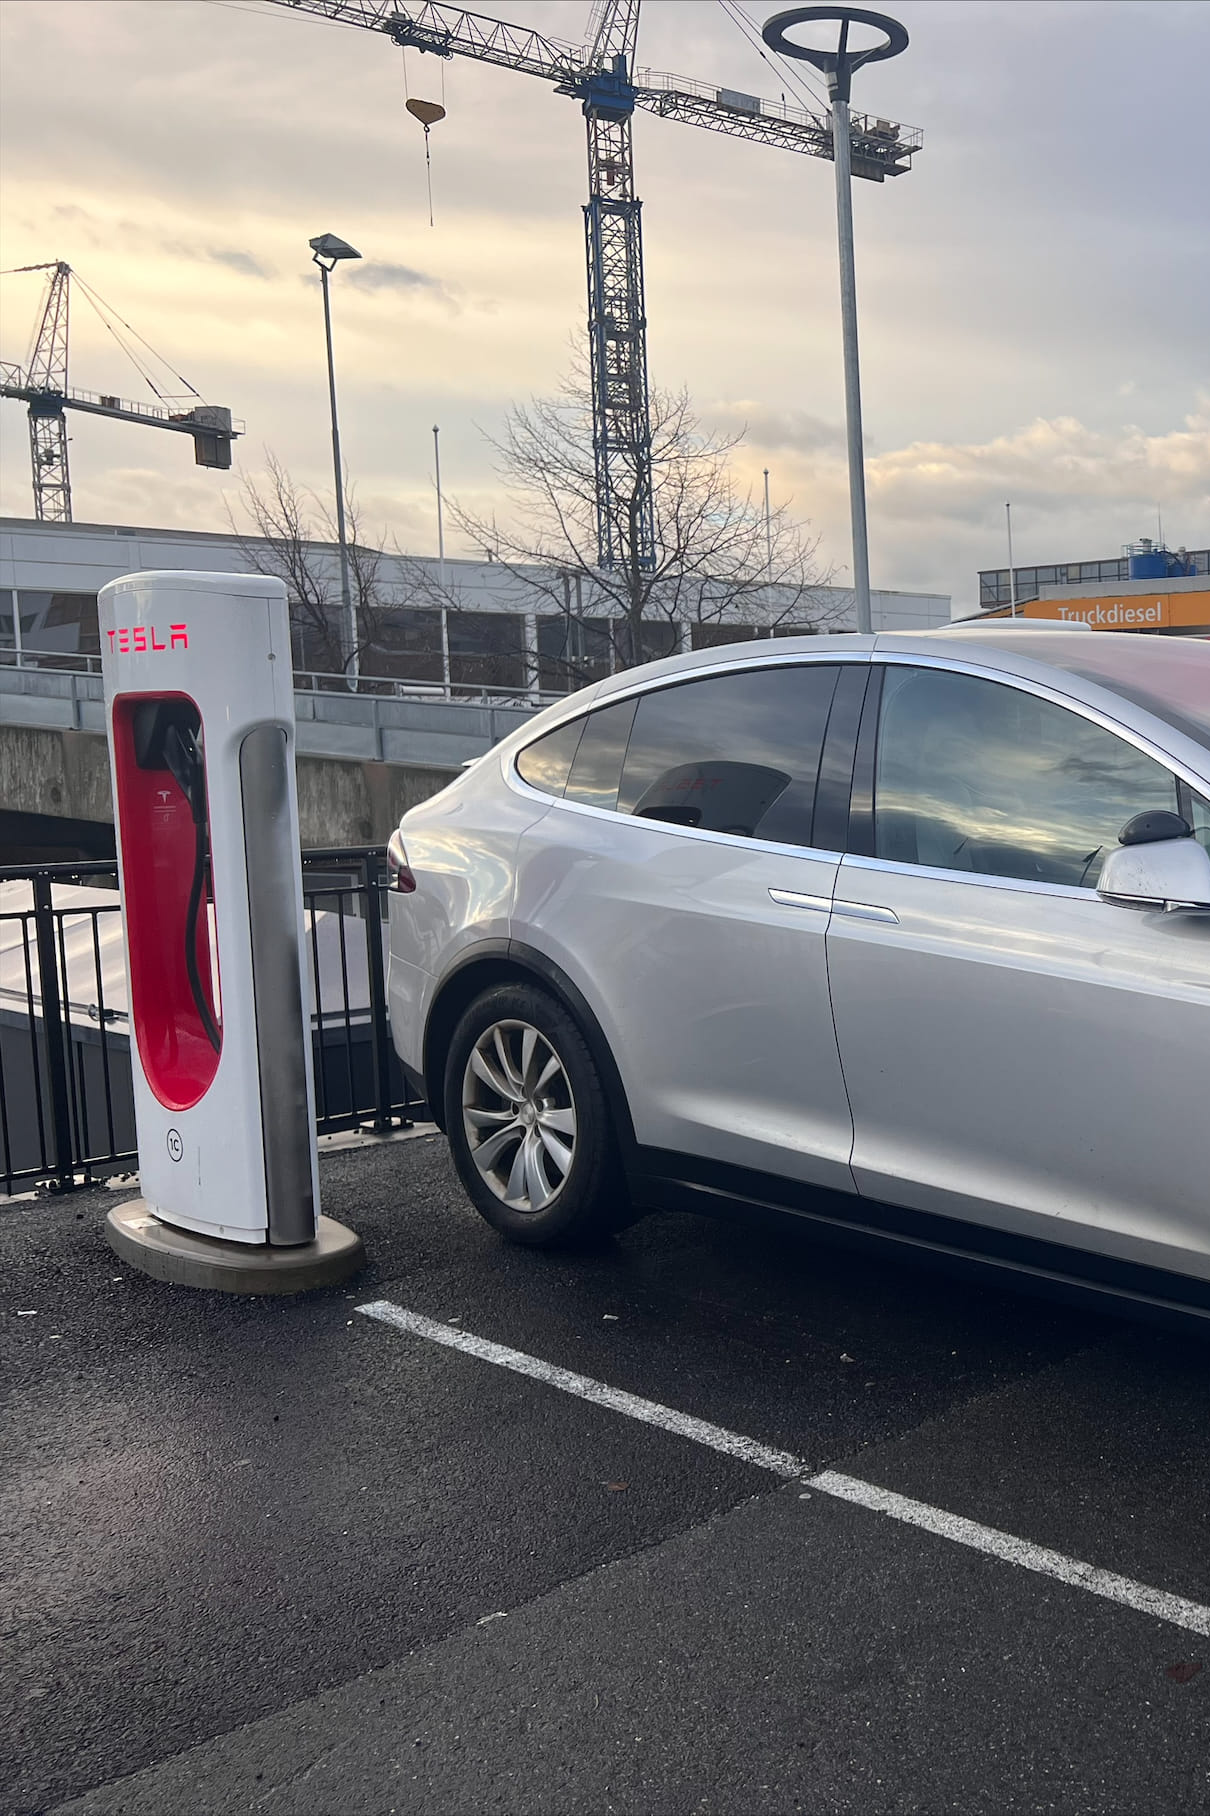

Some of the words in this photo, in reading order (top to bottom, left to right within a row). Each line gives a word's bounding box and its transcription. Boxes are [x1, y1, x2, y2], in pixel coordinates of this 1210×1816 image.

[1057, 601, 1161, 625] Truckdiesel
[107, 624, 189, 654] TESLA
[169, 1138, 180, 1152] 1C
